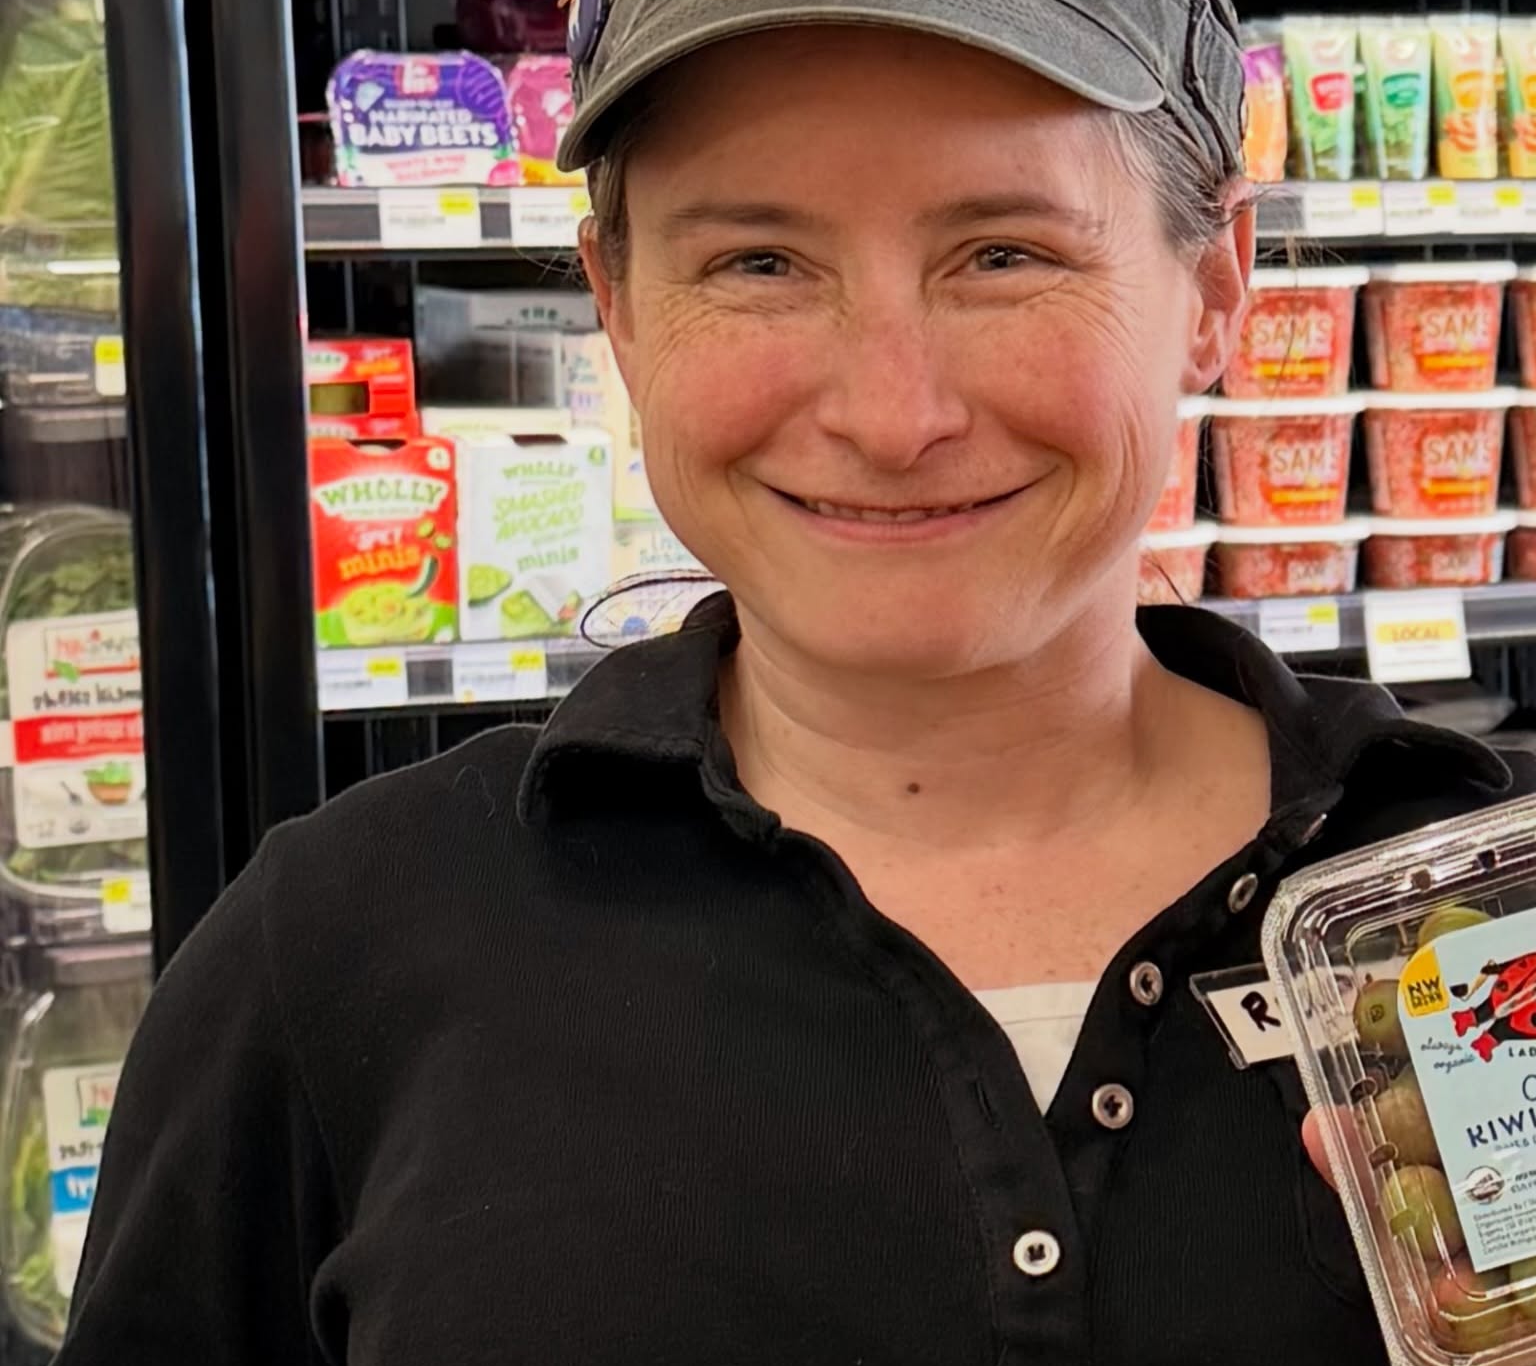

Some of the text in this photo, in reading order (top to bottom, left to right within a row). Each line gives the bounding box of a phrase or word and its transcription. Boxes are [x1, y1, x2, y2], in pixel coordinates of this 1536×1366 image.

[347, 122, 498, 147] BABY BEETS
[321, 478, 443, 506] WHOLLY
[338, 545, 421, 580] minis
